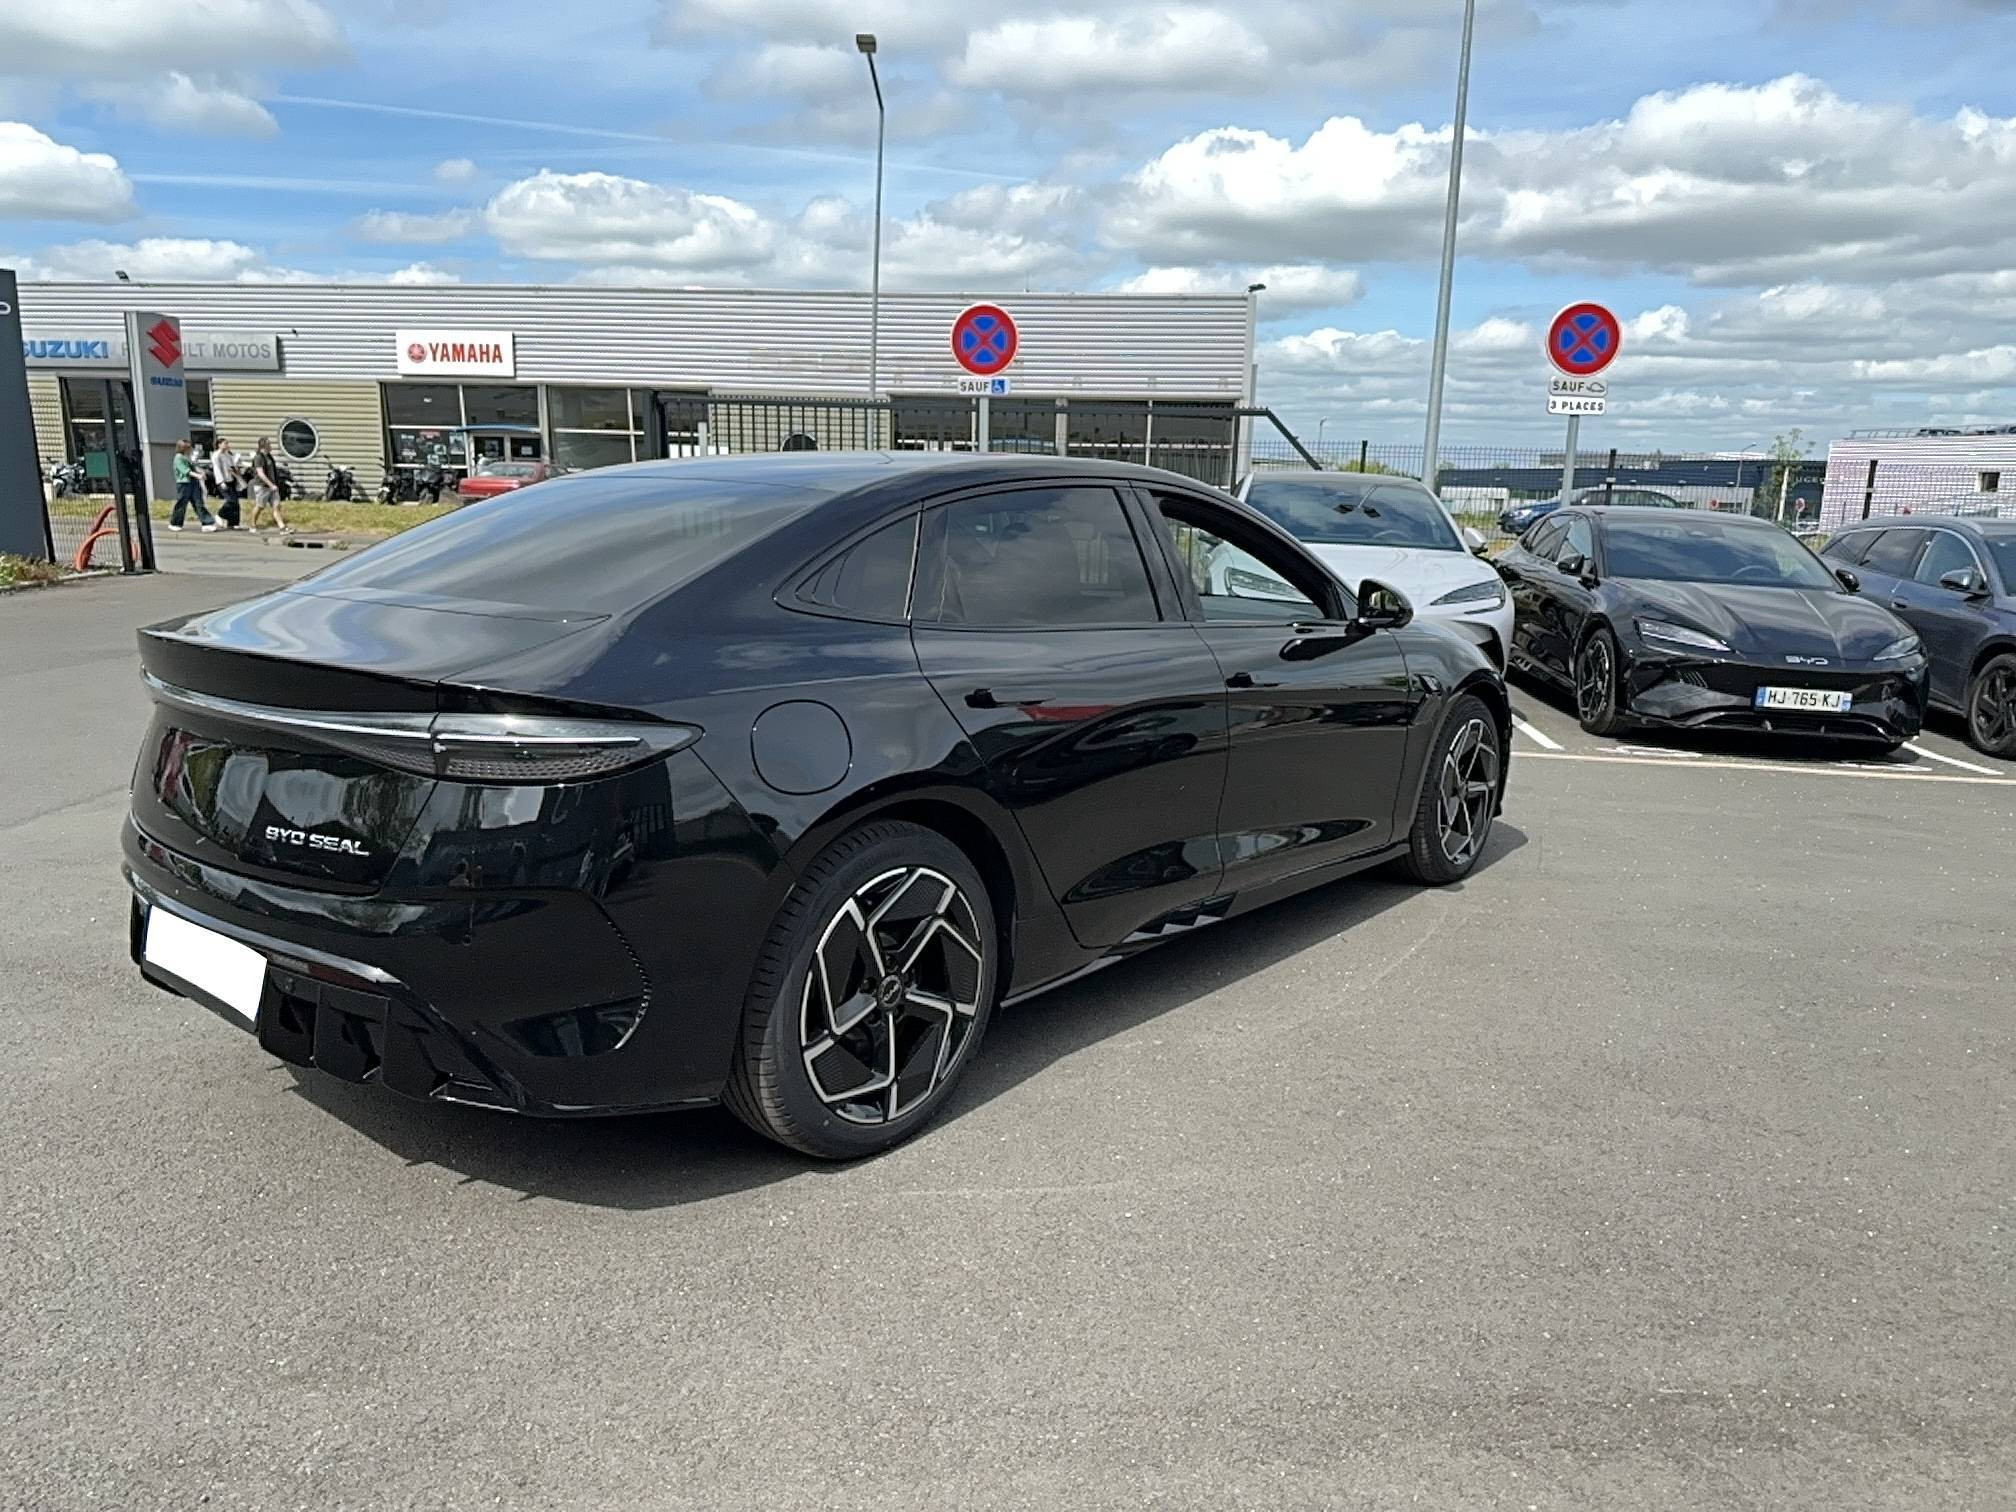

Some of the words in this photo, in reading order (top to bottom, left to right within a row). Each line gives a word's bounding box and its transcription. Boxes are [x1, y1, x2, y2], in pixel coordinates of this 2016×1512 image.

[213, 343, 271, 359] MOTOS
[428, 343, 503, 363] YAMAHA
[960, 381, 989, 392] SAUF
[1553, 380, 1585, 392] SAUF
[1550, 401, 1557, 410] 3
[1562, 401, 1604, 411] PLACES
[1792, 692, 1817, 706] 765
[265, 826, 305, 846] BYD
[309, 833, 370, 857] SEAL
